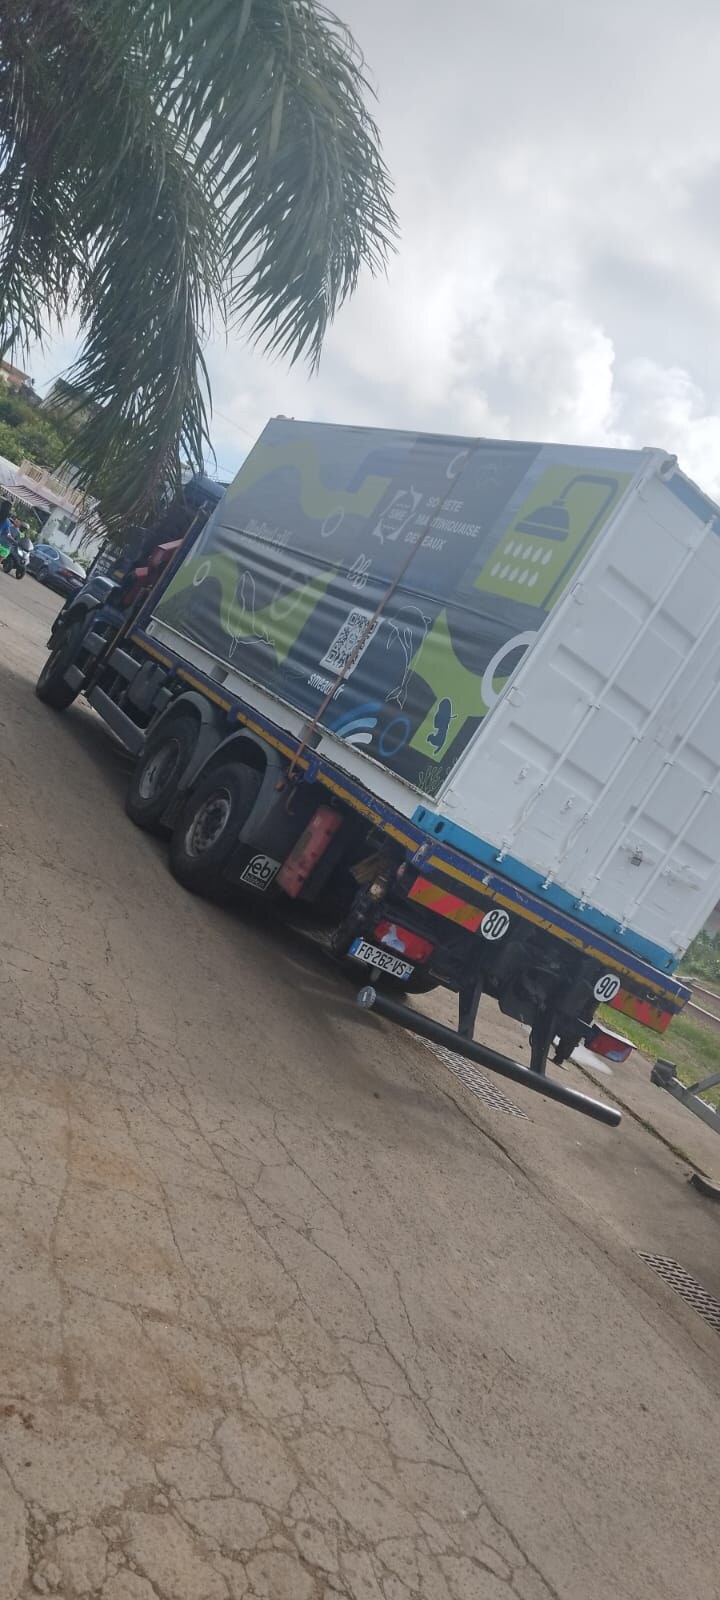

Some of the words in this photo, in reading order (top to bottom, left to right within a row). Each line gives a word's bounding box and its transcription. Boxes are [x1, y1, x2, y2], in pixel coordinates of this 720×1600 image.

[426, 496, 464, 512] SOIETE
[420, 535, 447, 551] EAUX
[483, 911, 507, 938] 80
[356, 944, 407, 976] FG-262-VS
[596, 976, 618, 999] 90
